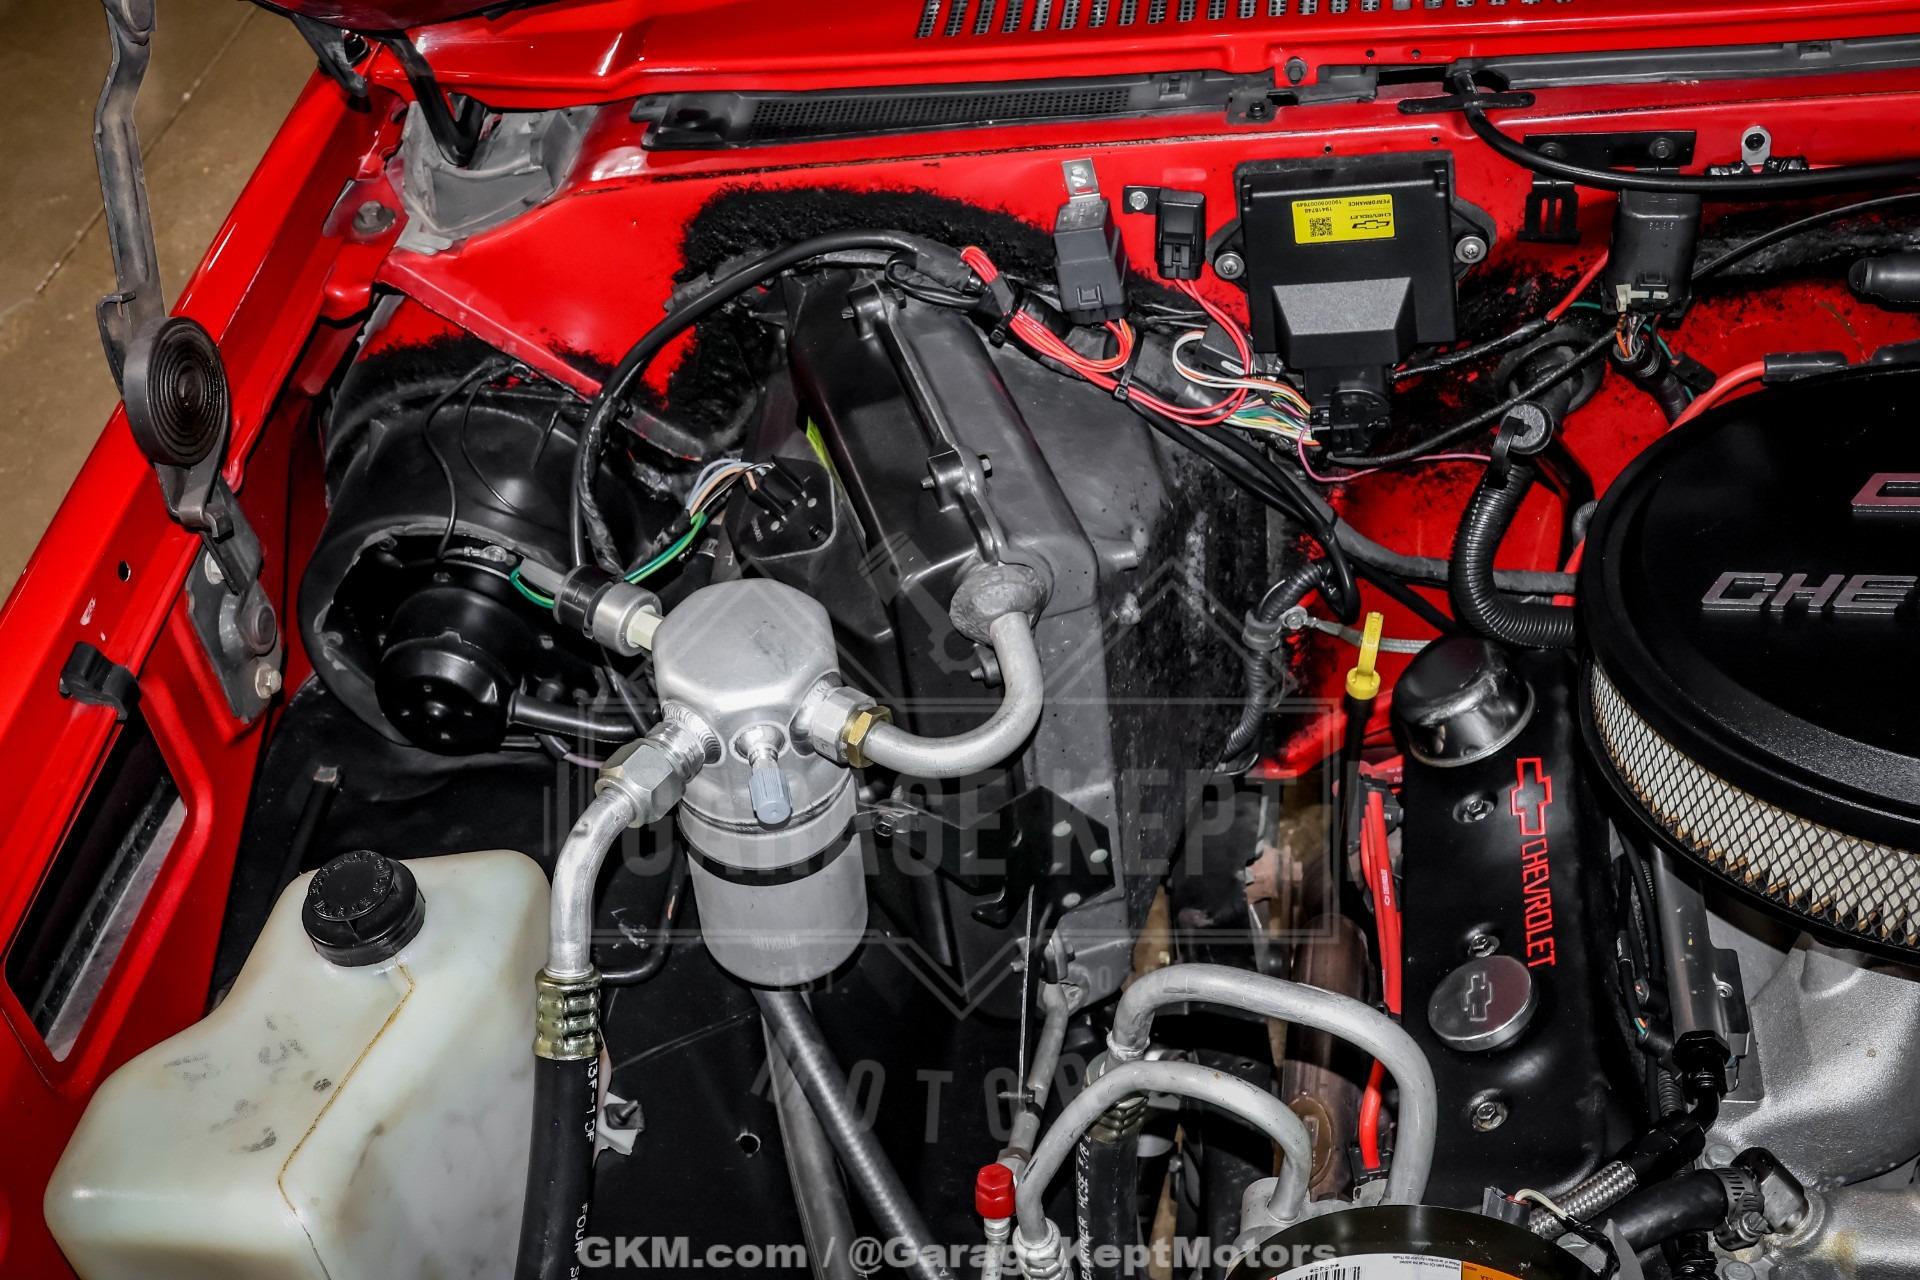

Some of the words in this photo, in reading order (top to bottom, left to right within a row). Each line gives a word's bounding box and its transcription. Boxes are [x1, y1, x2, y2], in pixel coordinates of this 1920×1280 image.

[1349, 198, 1391, 207] PERFORMANCE
[1350, 212, 1392, 220] CHEVROLET
[1521, 837, 1556, 967] CHEVROLET
[1077, 1171, 1089, 1209] HOSE
[575, 1202, 588, 1254] FOUR
[1078, 1215, 1092, 1280] BARRIER
